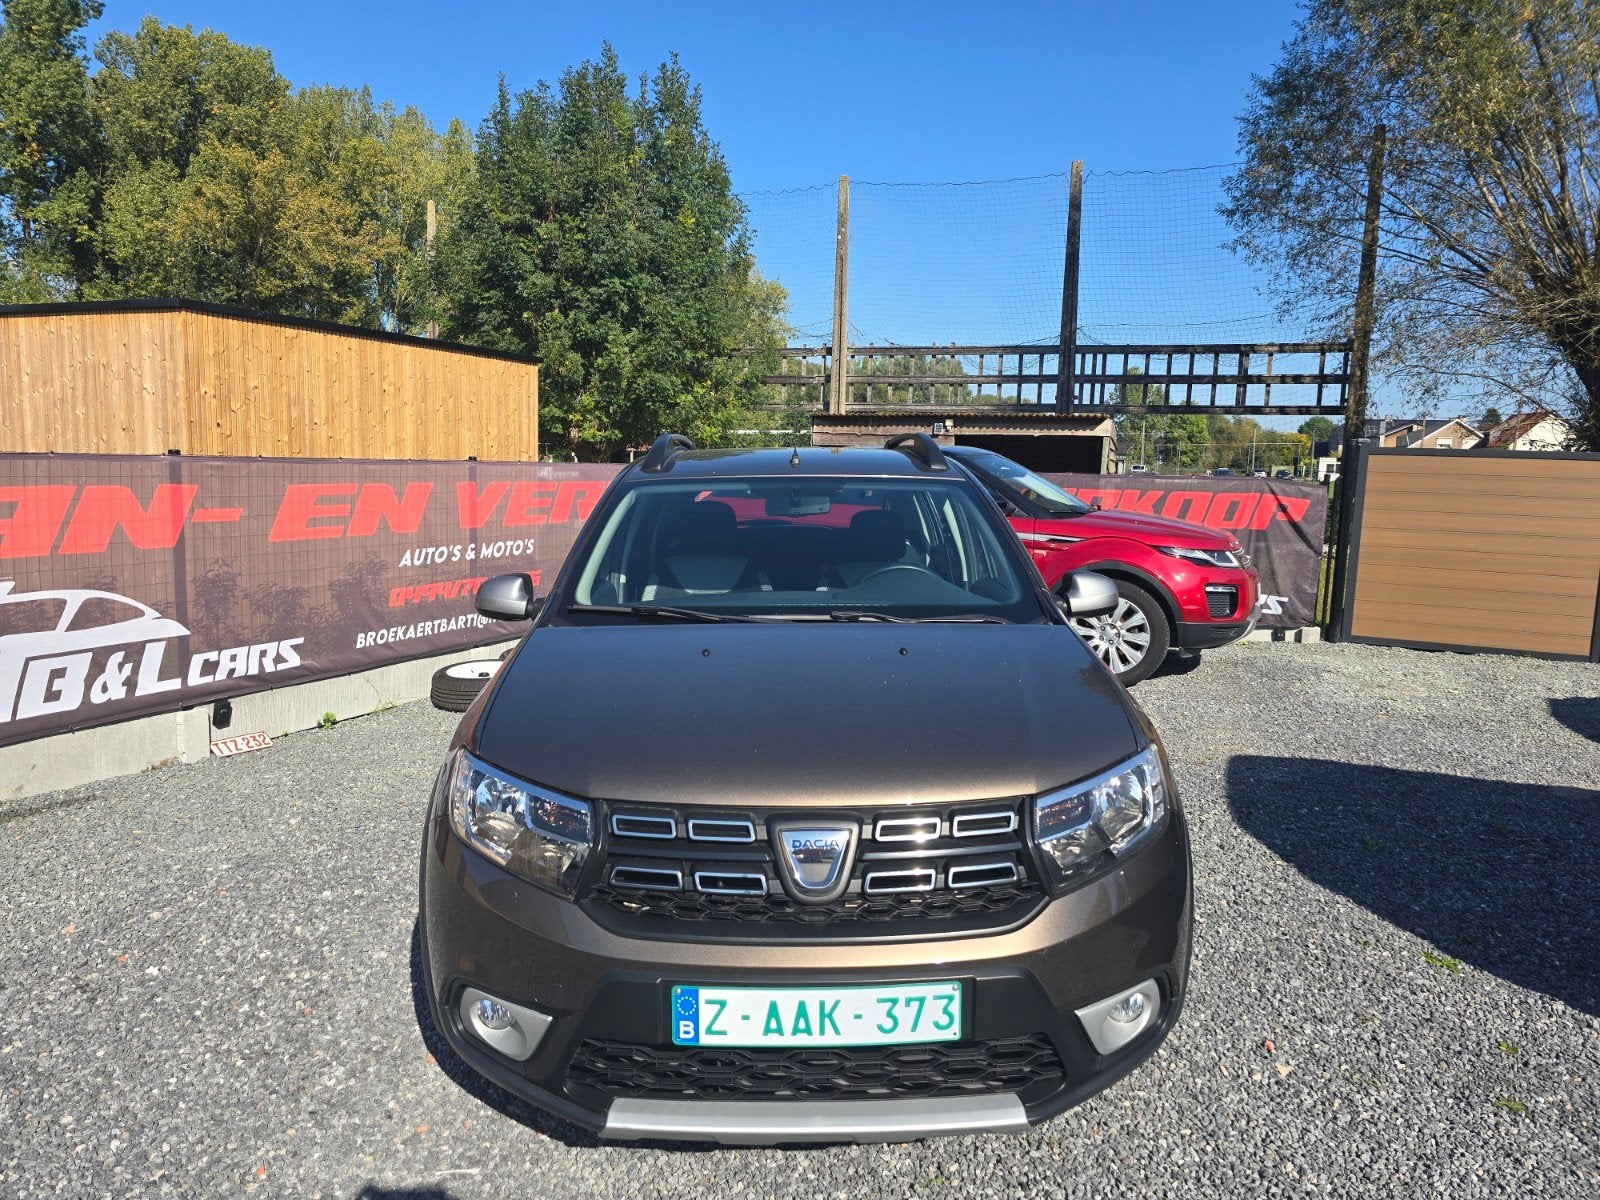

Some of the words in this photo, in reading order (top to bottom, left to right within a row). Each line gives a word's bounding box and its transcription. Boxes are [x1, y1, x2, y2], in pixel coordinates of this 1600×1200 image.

[268, 482, 433, 542] EN
[1063, 487, 1311, 531] RKOOP
[399, 545, 462, 567] AUTO'S
[466, 543, 476, 561] &
[480, 538, 535, 559] MOTO'S
[187, 637, 305, 686] CARS
[791, 838, 840, 849] DACIA
[679, 1021, 695, 1039] B
